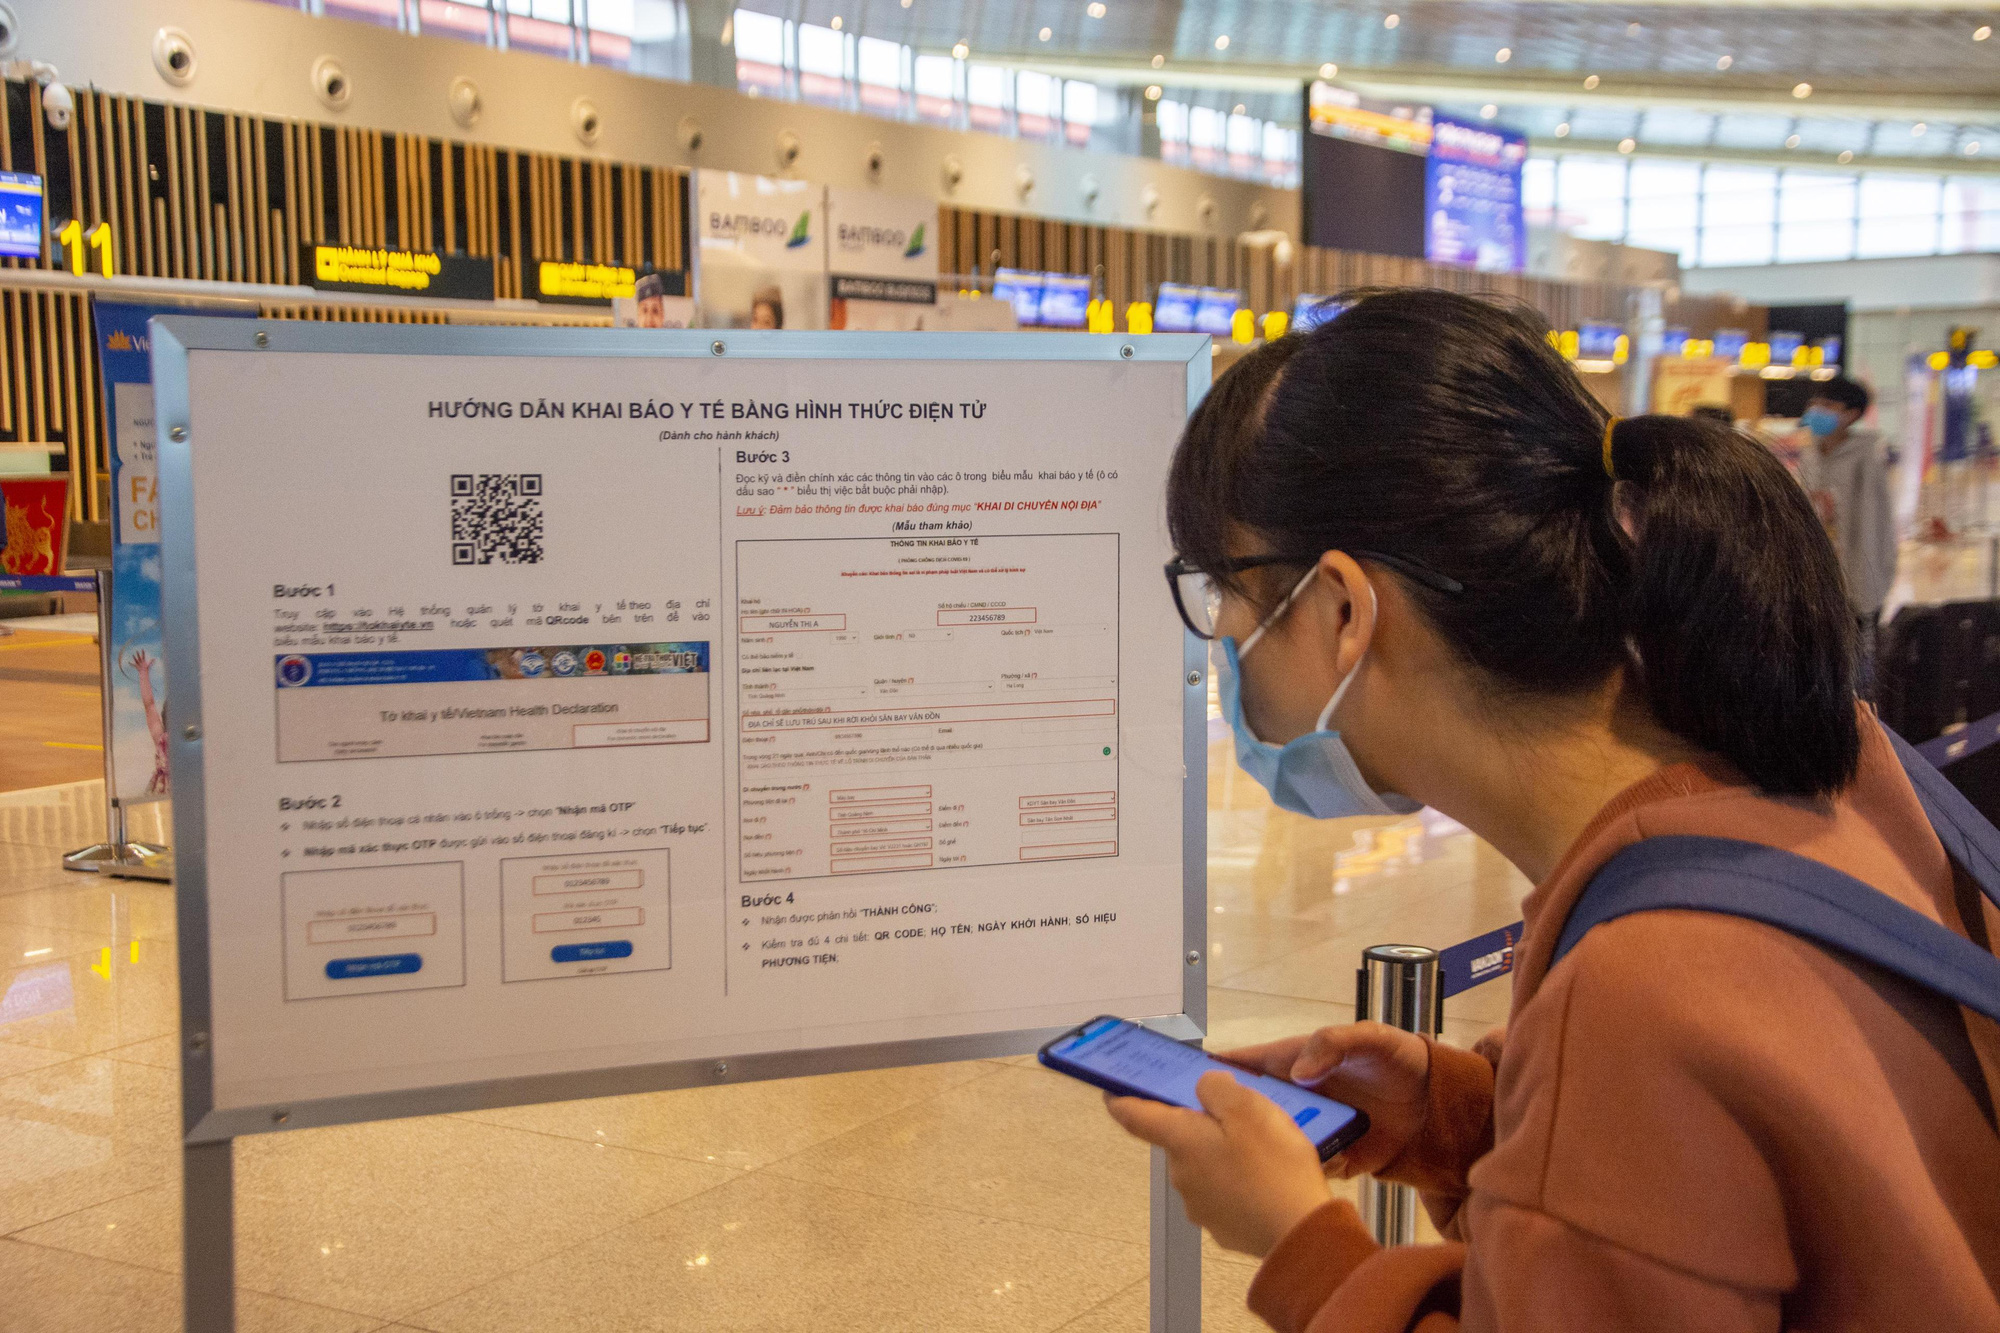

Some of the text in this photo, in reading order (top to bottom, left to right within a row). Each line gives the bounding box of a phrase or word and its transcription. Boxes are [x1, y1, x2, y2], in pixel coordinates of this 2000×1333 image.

[710, 212, 788, 236] BAMBOO
[837, 223, 905, 247] BAMBOO
[60, 219, 114, 280] 11
[428, 398, 512, 419] HƯỚNG
[520, 399, 564, 418] DẪN
[572, 402, 622, 419] KHAI
[629, 399, 674, 419] BÁO
[680, 402, 693, 418] Y
[731, 399, 789, 419] BẰNG
[796, 399, 842, 419] HÌNH
[849, 399, 903, 419] THỨC
[909, 400, 953, 422] ĐIỆN
[960, 399, 987, 419] TỬ
[659, 431, 779, 442] (Dành cho hành khách)
[736, 451, 790, 463] Bước 3
[736, 469, 1118, 484] Đọc kỹ và điền chính xác các thông tin vào các ô trong biểu mẫu khai báo y tế (ô có
[736, 485, 949, 496] dấu sao biểu thị việc bắt buộc phải nhập).
[736, 506, 756, 515] Lưu
[770, 505, 791, 514] Đảm
[795, 505, 812, 514] bảo
[815, 505, 841, 515] thông
[844, 504, 856, 513] tin
[858, 503, 882, 514] được
[884, 503, 904, 513] khai
[907, 503, 924, 513] báo
[927, 502, 949, 513] đúng
[952, 503, 971, 513] mục
[1004, 501, 1014, 510] DI
[1061, 500, 1078, 512] NỘI
[892, 519, 972, 531] (Mẫu tham khảo)
[928, 539, 945, 547] KHAI
[947, 538, 962, 546] BÁO
[273, 583, 335, 597] Bước 1
[558, 598, 710, 612] khai y theo địa chỉ
[526, 611, 710, 626] mã QRcode bên trên để vào
[769, 619, 798, 629] NGUYỄN
[801, 620, 812, 628] THỊ
[969, 614, 1005, 622] 223456789
[401, 709, 427, 721] khai
[430, 711, 438, 722] y
[510, 704, 548, 717] Health
[552, 702, 619, 715] Declaration
[748, 720, 761, 728] ĐỊA
[762, 718, 775, 727] CHỈ
[786, 718, 800, 727] LƯU
[847, 715, 859, 724] RỜI
[860, 714, 877, 723] KHỎI
[879, 713, 893, 722] SÂN
[908, 711, 923, 721] VÂN
[924, 710, 940, 720] ĐỒN
[278, 795, 341, 810] Bước 2
[527, 804, 606, 819] chọn mã
[411, 826, 657, 849] OTP đăng chọn
[741, 892, 794, 908] Bước 4
[761, 914, 787, 926] Nhận
[789, 912, 814, 924] được
[817, 910, 840, 922] phản
[843, 909, 857, 919] hồi
[761, 938, 786, 950] Kiểm
[790, 939, 803, 948] tra
[808, 936, 819, 946] đủ
[824, 936, 830, 944] 4
[835, 934, 848, 944] chi
[875, 931, 889, 941] QR
[894, 928, 926, 939] CODE;
[931, 926, 946, 937] HỌ
[951, 923, 974, 935] TÊN;
[978, 920, 1006, 932] NGÀY
[1011, 918, 1036, 930] KHỞI
[1040, 915, 1071, 928] HÀNH;
[1075, 913, 1089, 925] SỐ
[1094, 912, 1117, 925] HIỆU
[762, 953, 839, 968] PHƯƠNG TIỆN;
